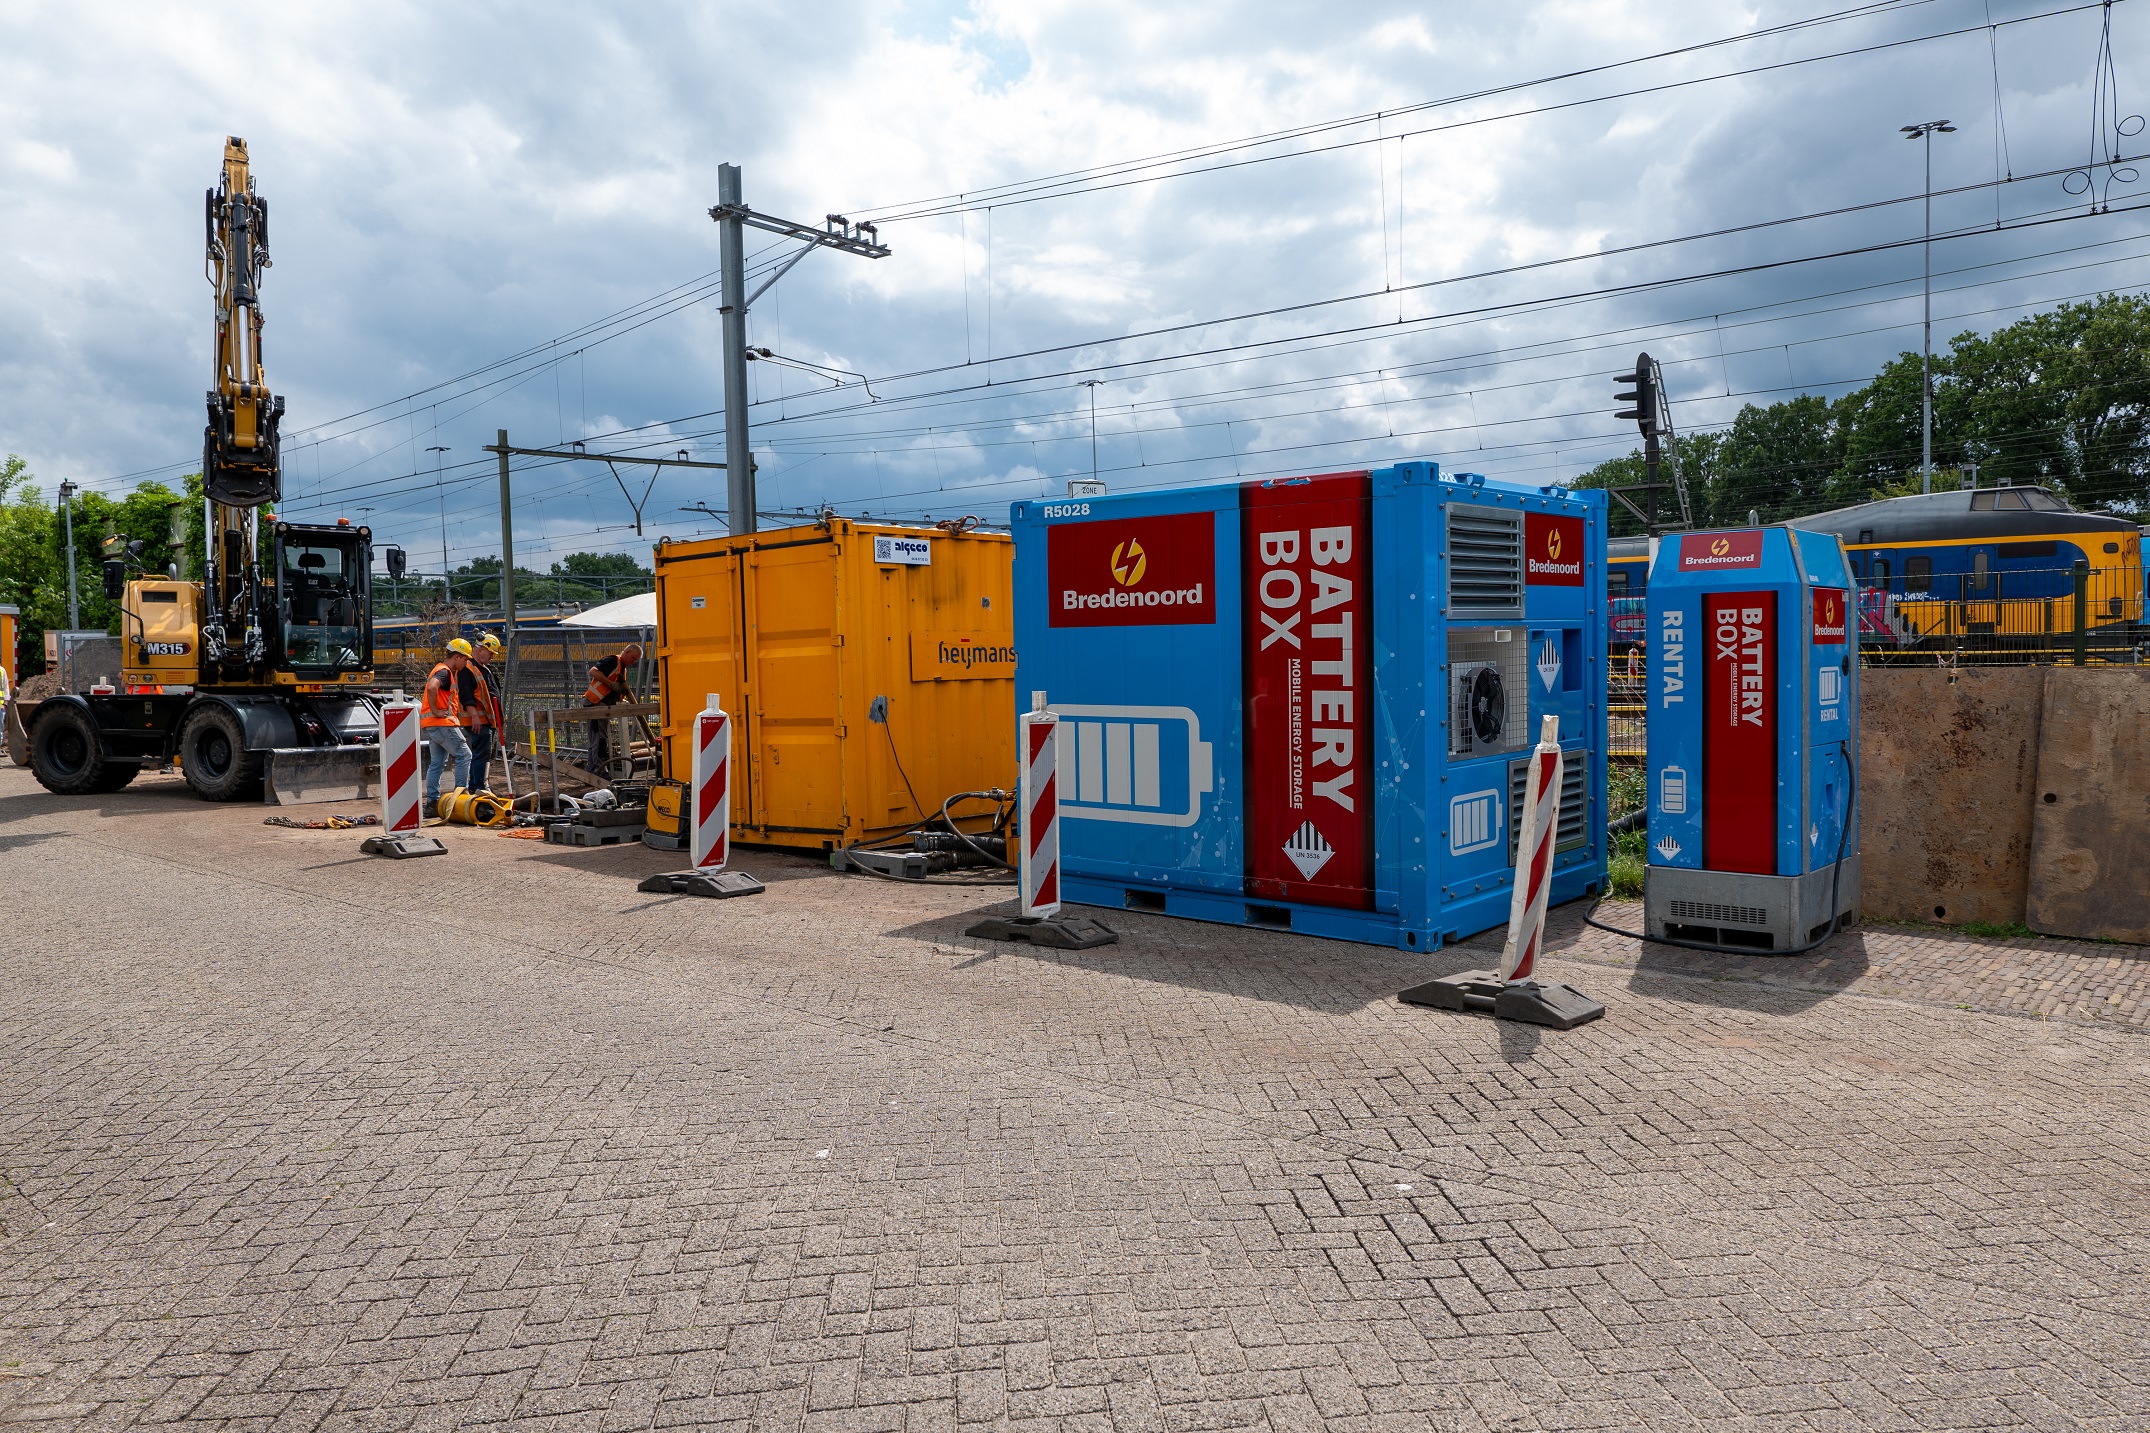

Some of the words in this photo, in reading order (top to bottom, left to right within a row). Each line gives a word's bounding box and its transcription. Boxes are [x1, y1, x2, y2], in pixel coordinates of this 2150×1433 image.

[1044, 503, 1091, 518] R5028
[1528, 558, 1580, 575] Bredenoord
[1685, 553, 1755, 565] Bredenoord
[1063, 583, 1203, 610] Bredenoord
[1259, 530, 1302, 652] BOX
[147, 643, 184, 655] M315
[1716, 608, 1738, 661] BOX
[1814, 624, 1845, 636] Bredenoord
[1292, 658, 1301, 703] MOBILE
[1310, 525, 1355, 813] BATTERY
[1663, 610, 1684, 709] RENTAL
[1742, 607, 1763, 727] BATTERY
[1292, 707, 1302, 753] ENERGY
[1820, 707, 1839, 722] RENTAL
[1293, 755, 1303, 810] STORAGE
